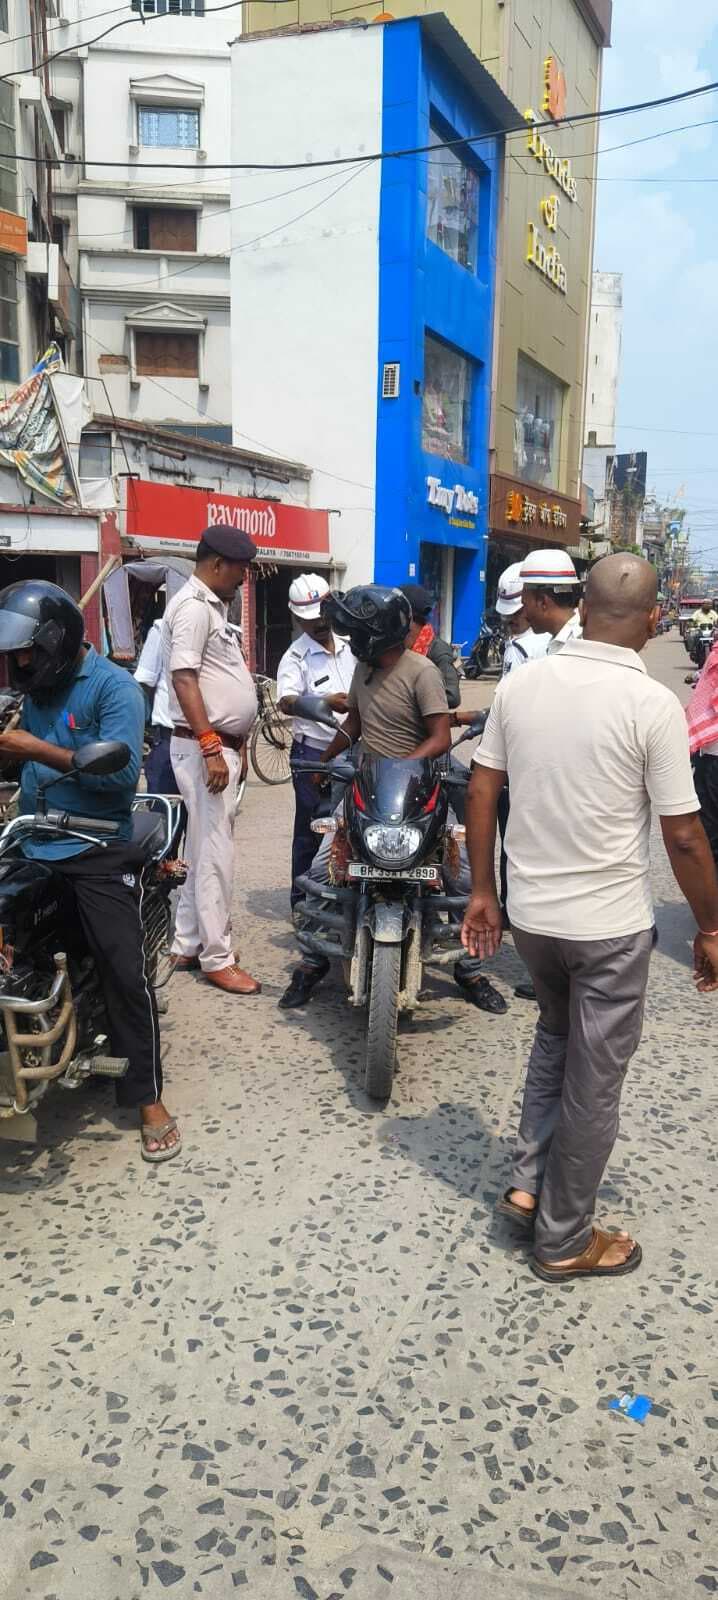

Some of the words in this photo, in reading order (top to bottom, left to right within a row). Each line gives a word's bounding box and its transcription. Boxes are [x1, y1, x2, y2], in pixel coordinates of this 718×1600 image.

[525, 109, 577, 202] Trends
[541, 194, 560, 231] of
[527, 222, 568, 296] India
[207, 502, 276, 537] Raymond
